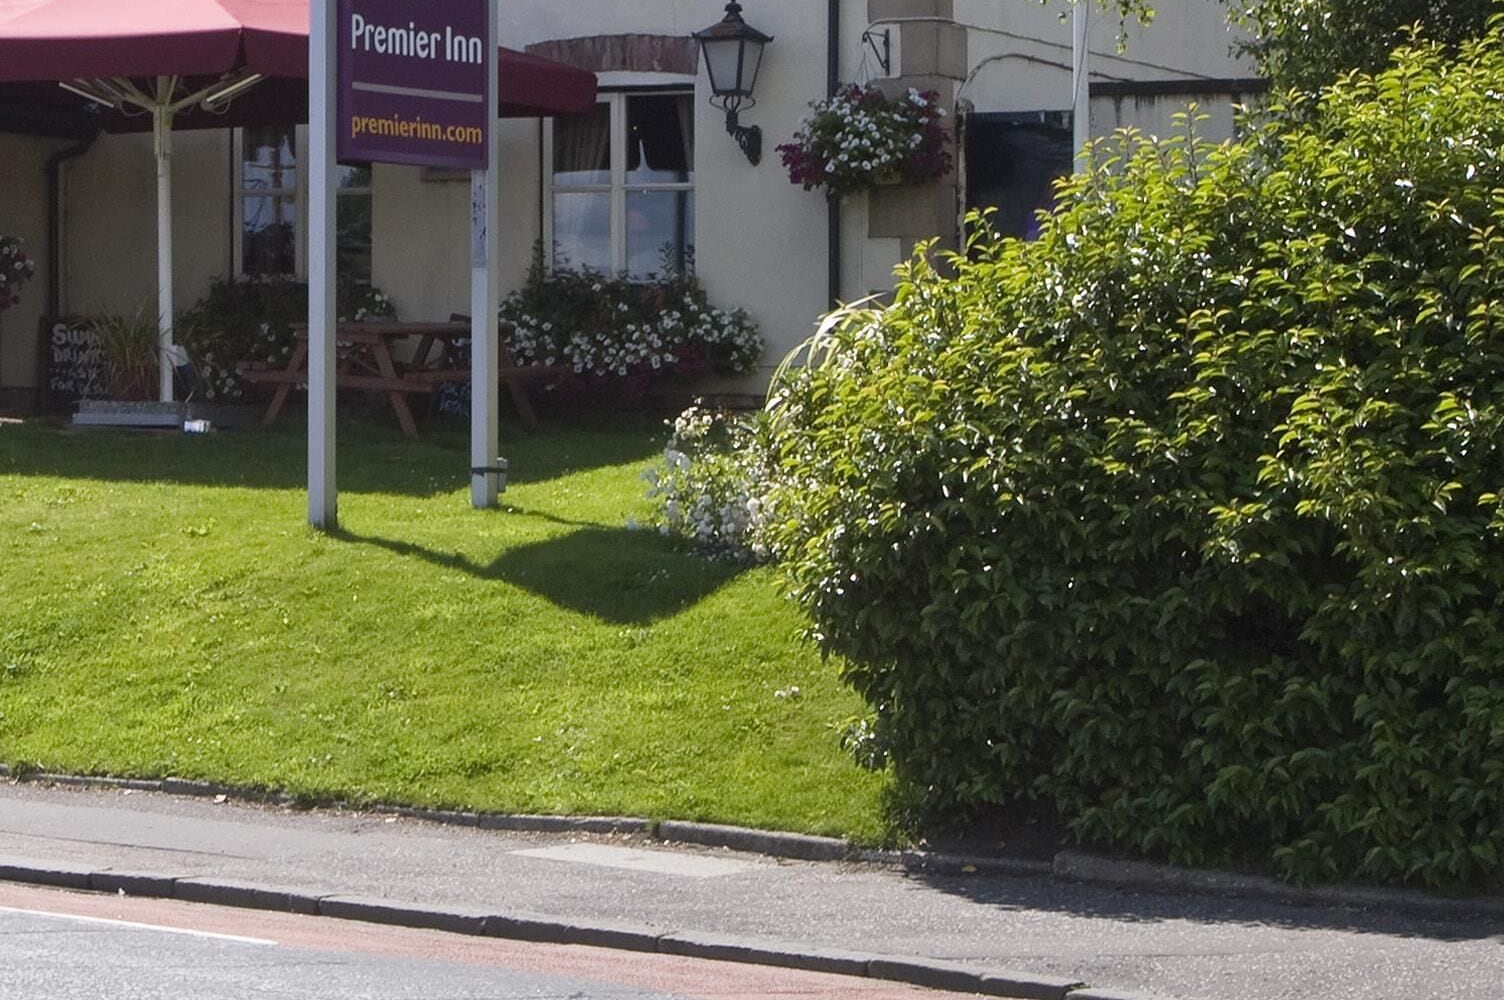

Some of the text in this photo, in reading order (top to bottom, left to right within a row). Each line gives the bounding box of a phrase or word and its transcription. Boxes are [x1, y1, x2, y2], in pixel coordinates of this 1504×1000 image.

[351, 13, 482, 65] Premier Inn
[351, 114, 483, 144] premierinn.com
